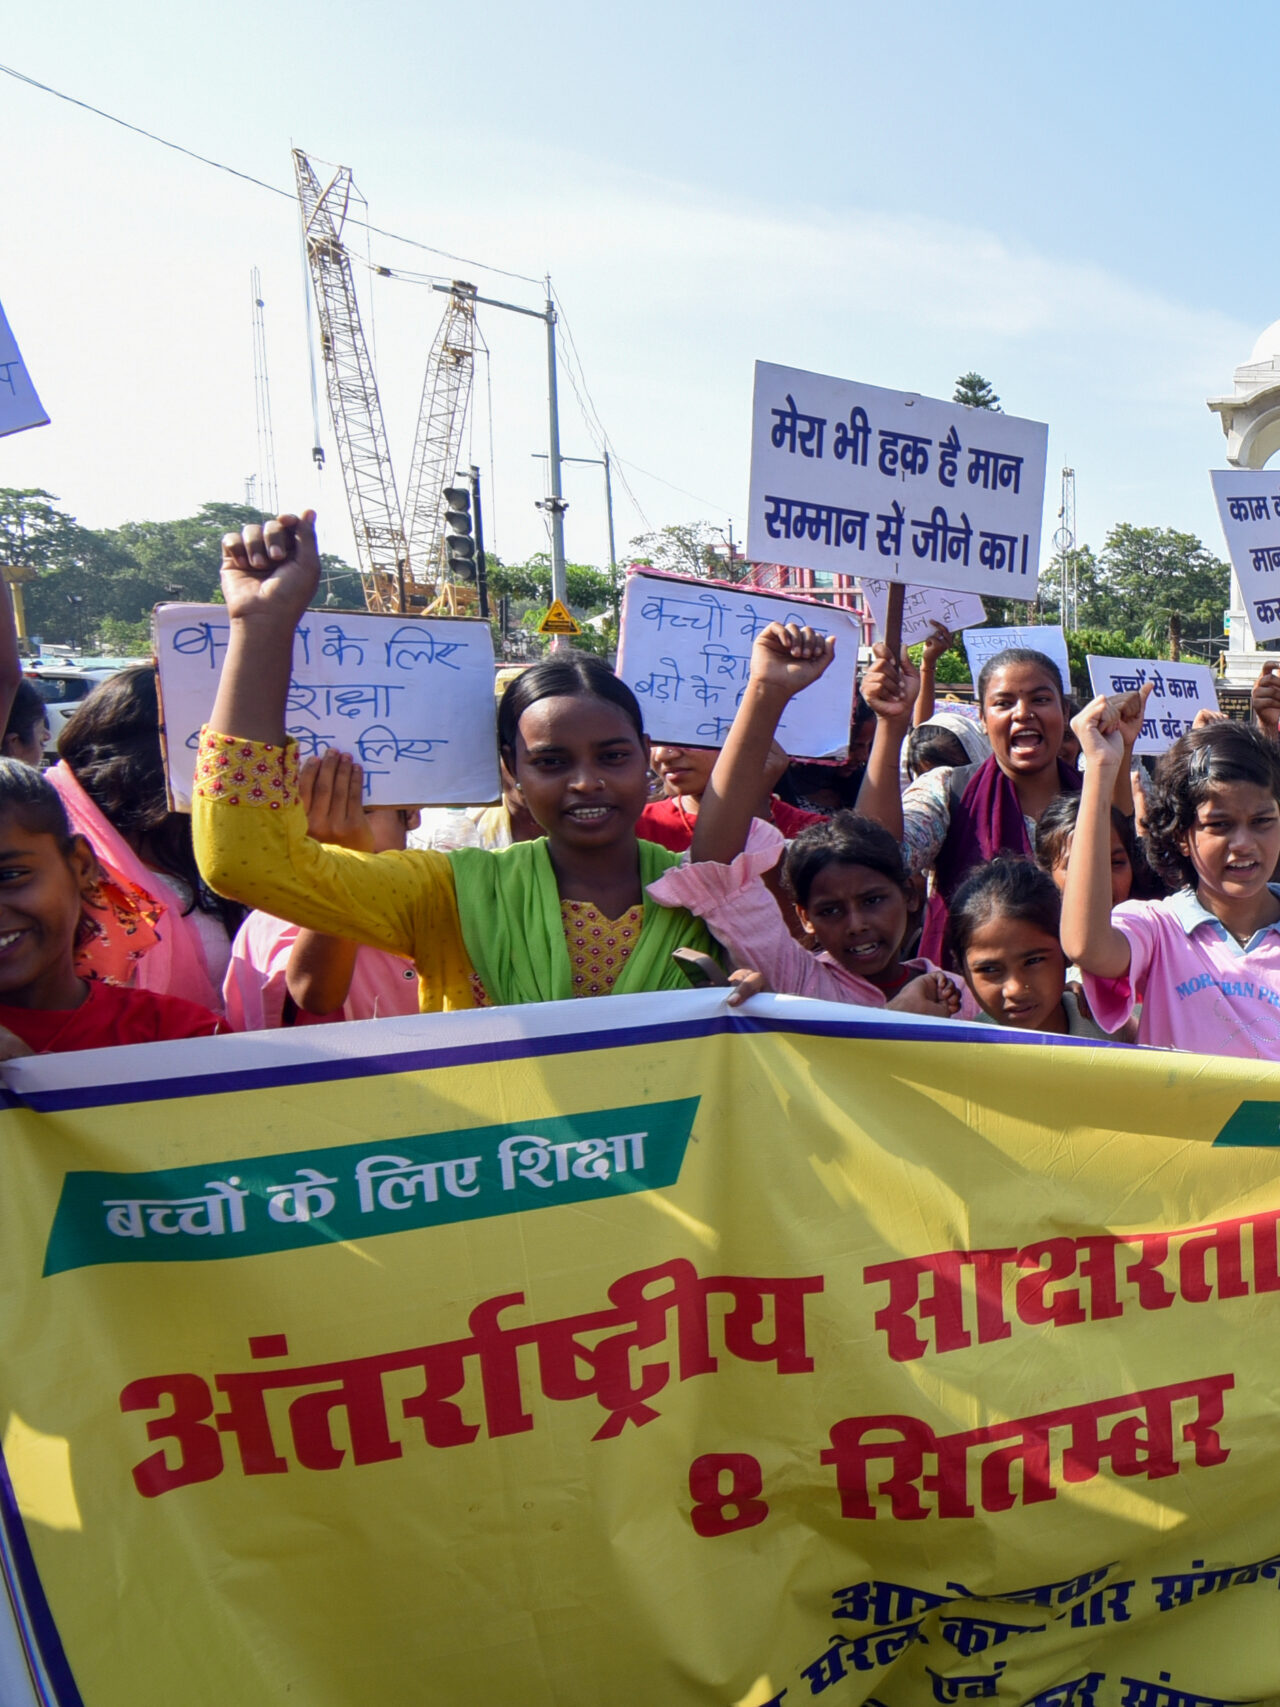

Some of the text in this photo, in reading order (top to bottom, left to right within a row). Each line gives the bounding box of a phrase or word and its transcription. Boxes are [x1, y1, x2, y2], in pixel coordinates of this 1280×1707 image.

[771, 393, 1024, 495] मेरा भी हक है मान
[1226, 496, 1270, 522] काम
[764, 495, 870, 552] सम्मान
[876, 500, 905, 557] से
[911, 506, 973, 567] जीने
[322, 625, 369, 666] के
[690, 675, 726, 707] के
[1110, 668, 1200, 700] बच्चों से काम
[1160, 712, 1183, 739] बंद
[103, 1131, 649, 1240] बच्चों के लिए शिक्षा
[119, 1257, 825, 1499] अंतर्राष्ट्रीय
[688, 1373, 1236, 1538] 8 सितम्बर
[925, 1661, 1007, 1704] एवं
